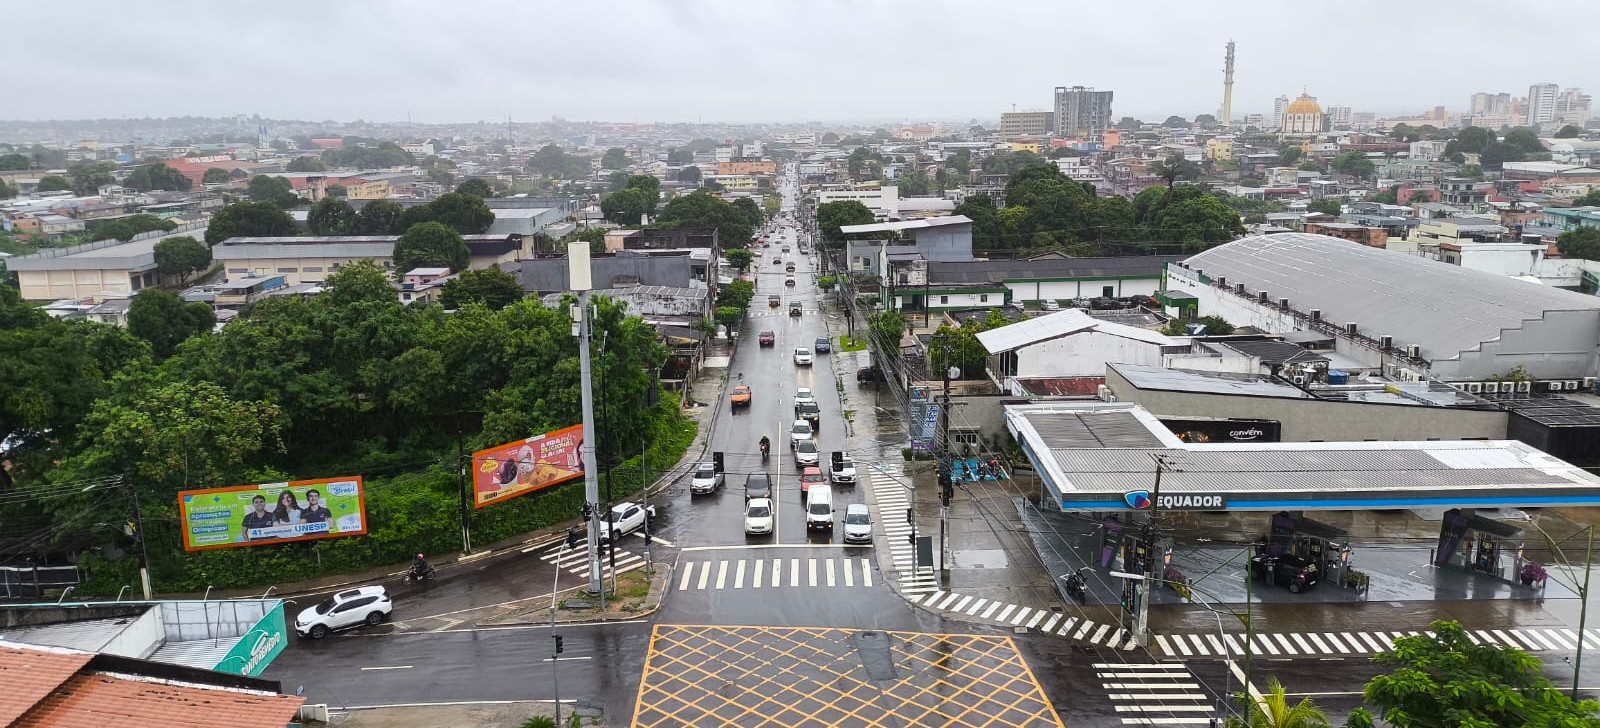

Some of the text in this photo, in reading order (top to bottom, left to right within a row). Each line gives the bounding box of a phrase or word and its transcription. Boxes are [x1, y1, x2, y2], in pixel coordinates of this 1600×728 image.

[1229, 427, 1263, 437] convém
[546, 438, 561, 447] VIDA
[1157, 496, 1222, 508] EQUADOR
[294, 523, 327, 533] UNESP
